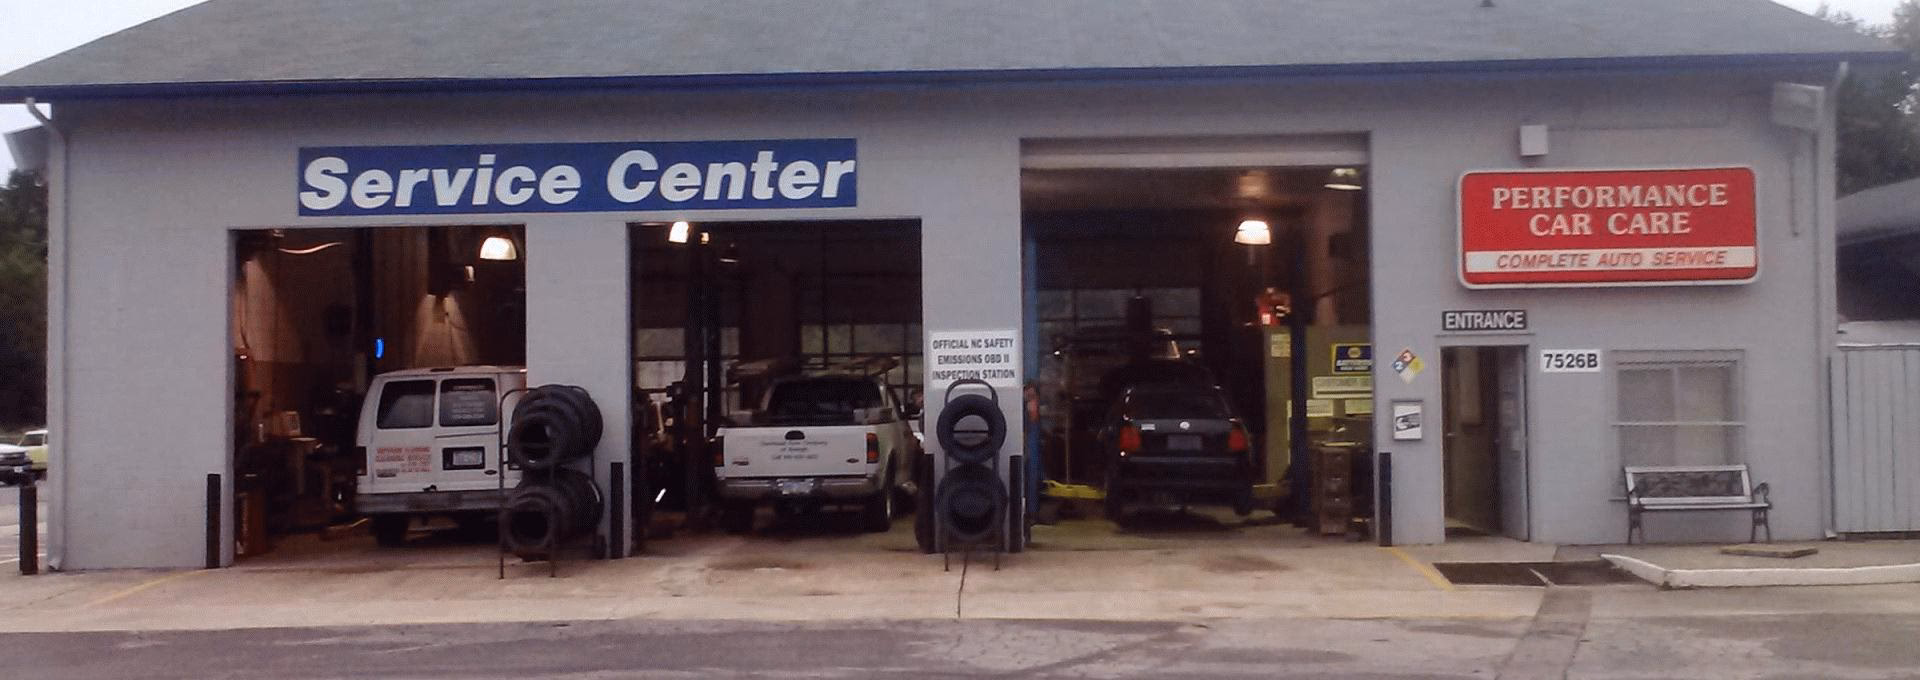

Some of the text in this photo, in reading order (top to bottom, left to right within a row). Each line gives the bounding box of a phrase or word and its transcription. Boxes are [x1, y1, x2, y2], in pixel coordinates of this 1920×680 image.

[300, 149, 856, 211] Service Center
[1492, 183, 1729, 210] PERFORMANCE
[1528, 211, 1692, 236] CAR CARE
[1496, 250, 1727, 269] COMPLETE AUTO SERVICE
[1445, 311, 1525, 329] ENTRANCE
[933, 338, 1014, 350] OFFICIAL NC SAFETY
[937, 354, 982, 365] EMISSIONS
[984, 353, 1002, 364] OBD
[1543, 353, 1598, 369] 7526B
[933, 369, 1016, 380] INSPECTION STATION
